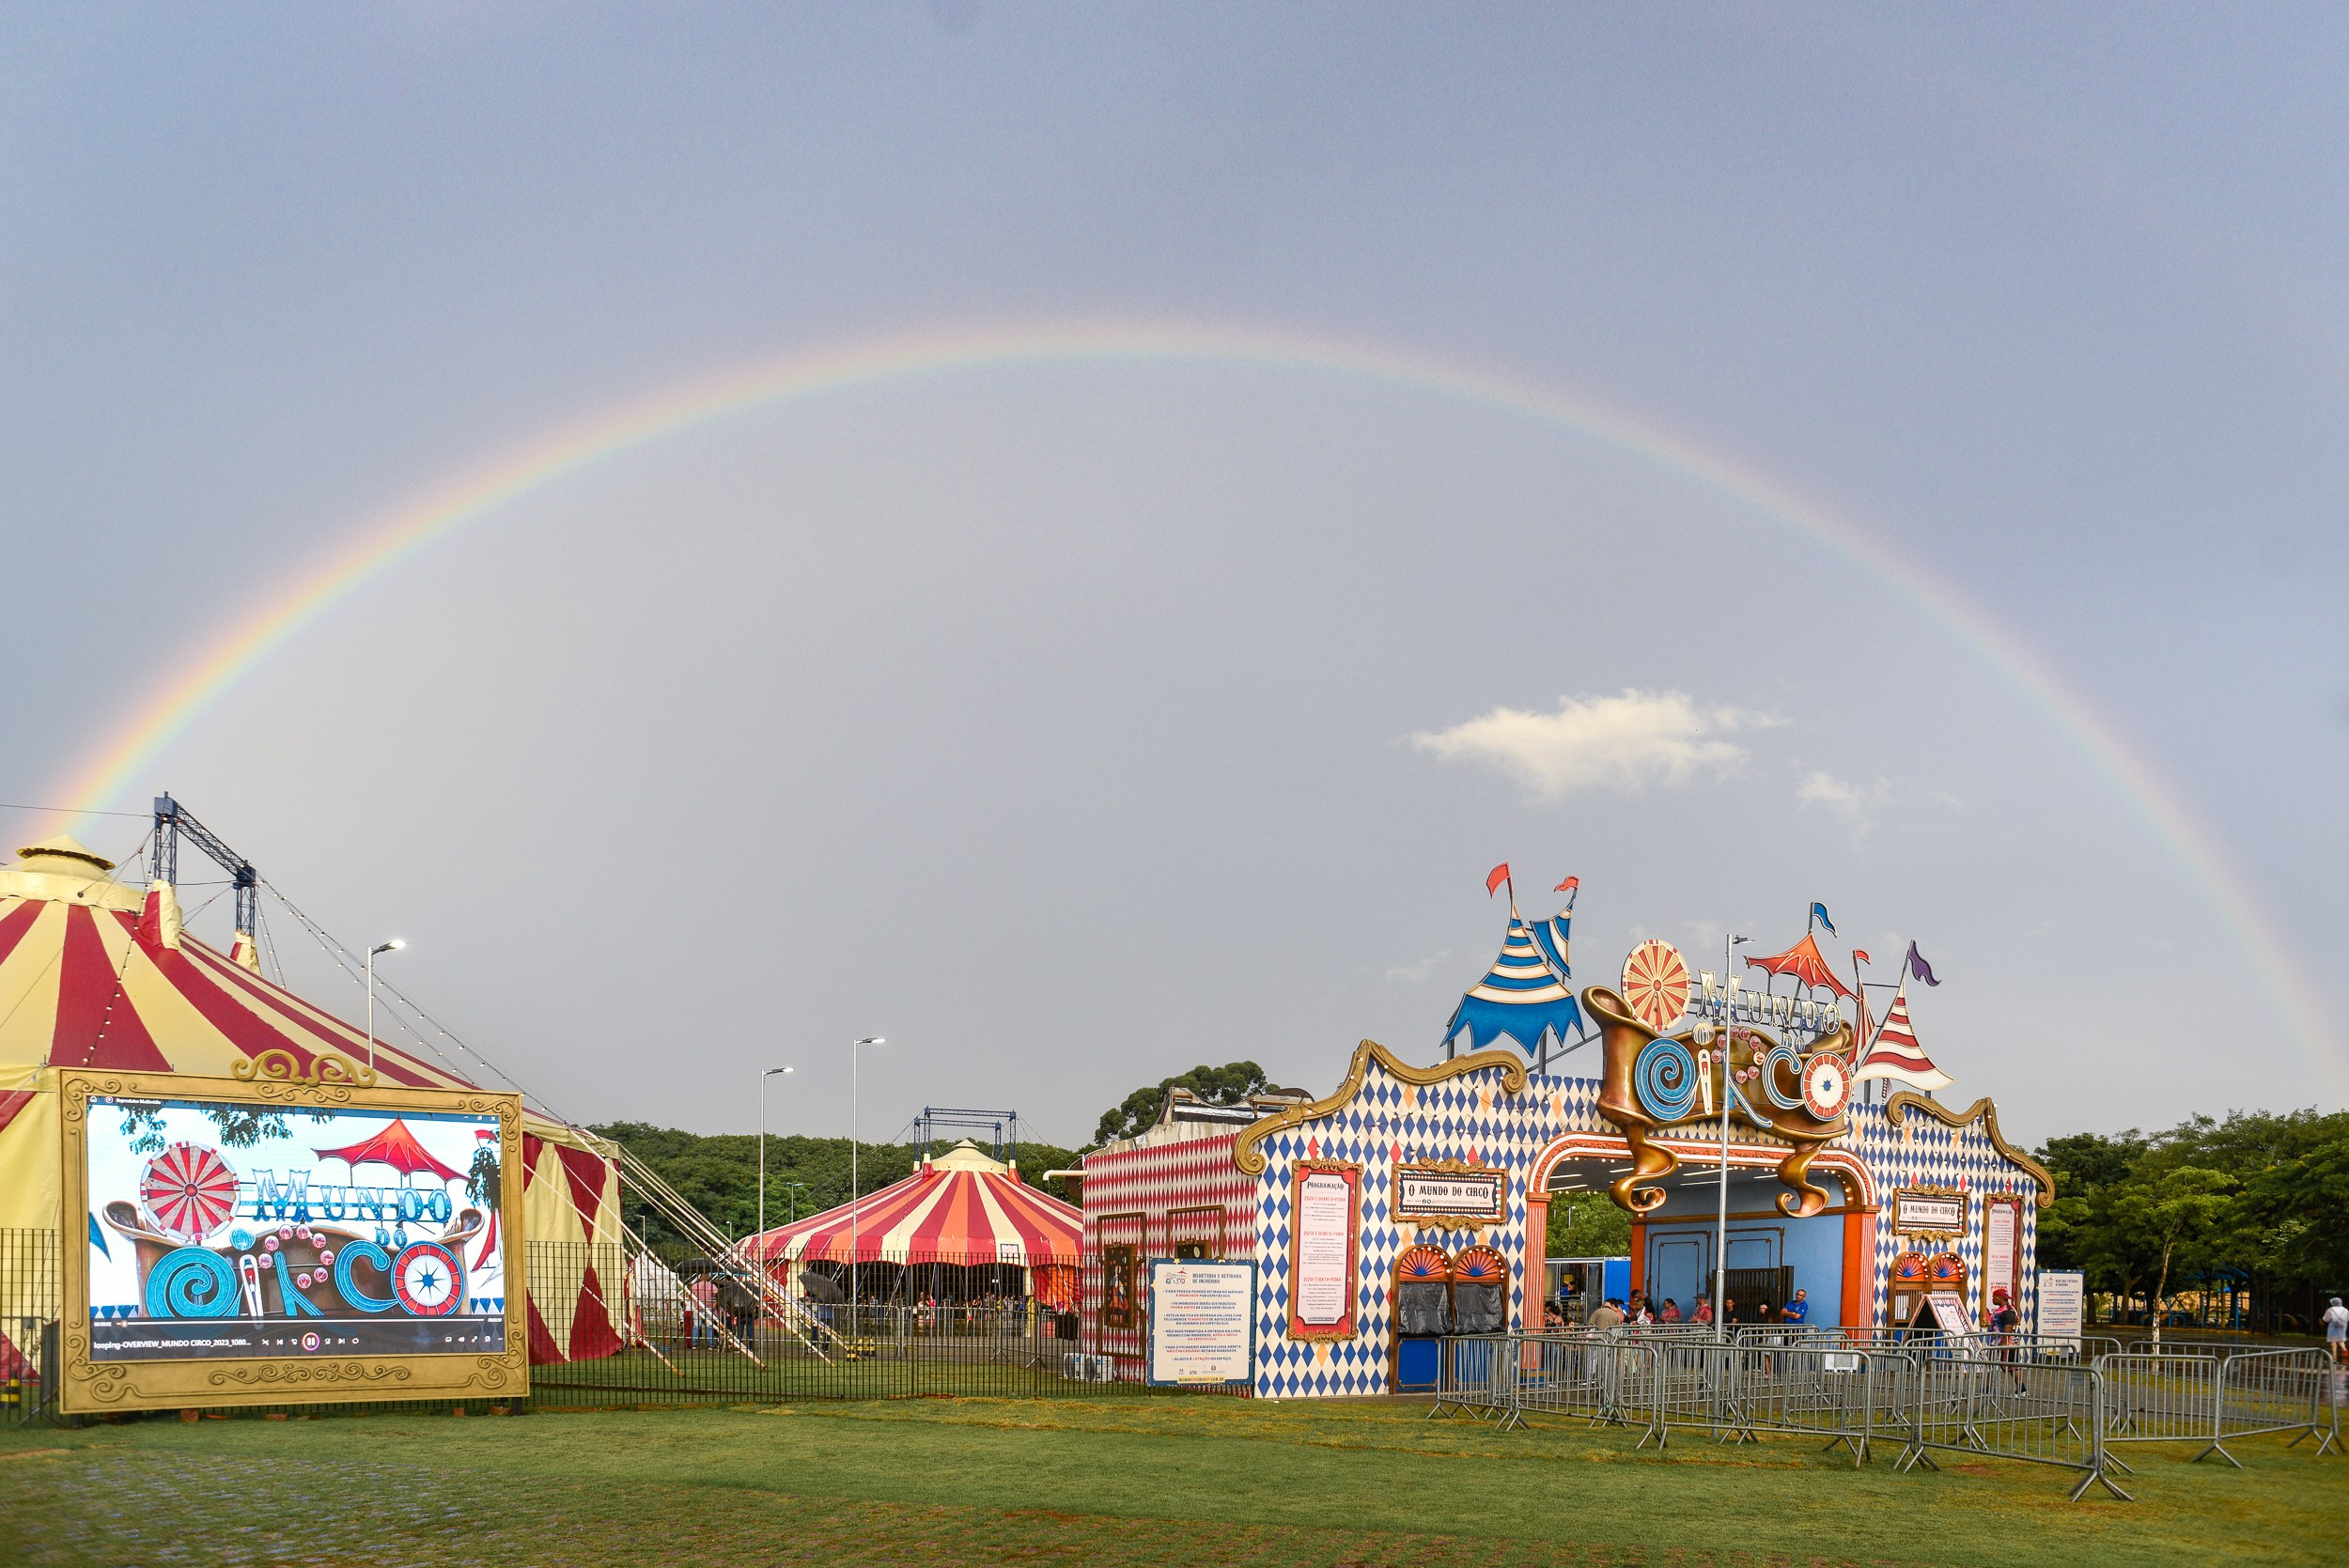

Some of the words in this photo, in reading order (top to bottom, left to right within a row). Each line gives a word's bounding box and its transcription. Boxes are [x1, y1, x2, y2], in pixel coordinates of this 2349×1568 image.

[1696, 970, 1841, 1034] MUNDO
[1781, 1032, 1805, 1054] DO
[1307, 1181, 1345, 1190] PROGRAMAÇÃO
[1409, 1184, 1415, 1196] O
[1419, 1186, 1448, 1196] MUNDO
[1452, 1187, 1462, 1196] DO
[1466, 1187, 1489, 1199] CIRCO
[250, 1169, 453, 1222] MUNDO
[1903, 1204, 1907, 1214] O
[1910, 1205, 1929, 1213] MUNDO
[1931, 1206, 1938, 1214] DO
[1940, 1207, 1955, 1216] CIRCO
[375, 1226, 408, 1249] DO
[94, 1340, 189, 1350] looping-OVERVIEW_MUNDO
